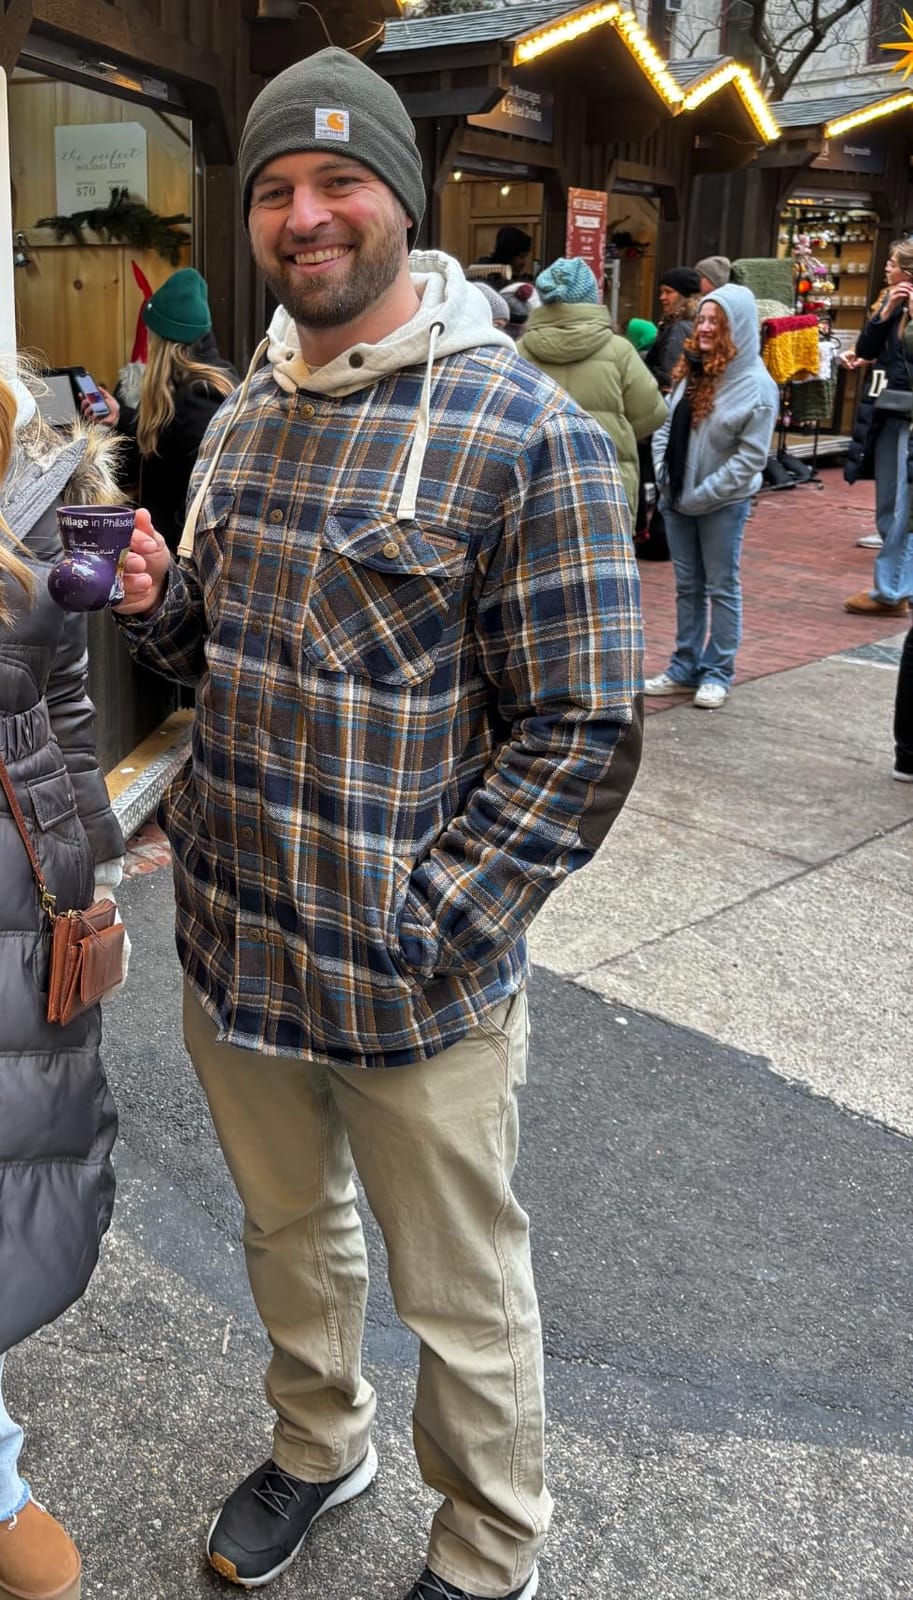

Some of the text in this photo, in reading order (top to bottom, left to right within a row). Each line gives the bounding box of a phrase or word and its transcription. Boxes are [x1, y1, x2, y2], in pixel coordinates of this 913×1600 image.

[90, 147, 139, 167] perfect
[60, 516, 89, 529] Village
[91, 517, 100, 528] in
